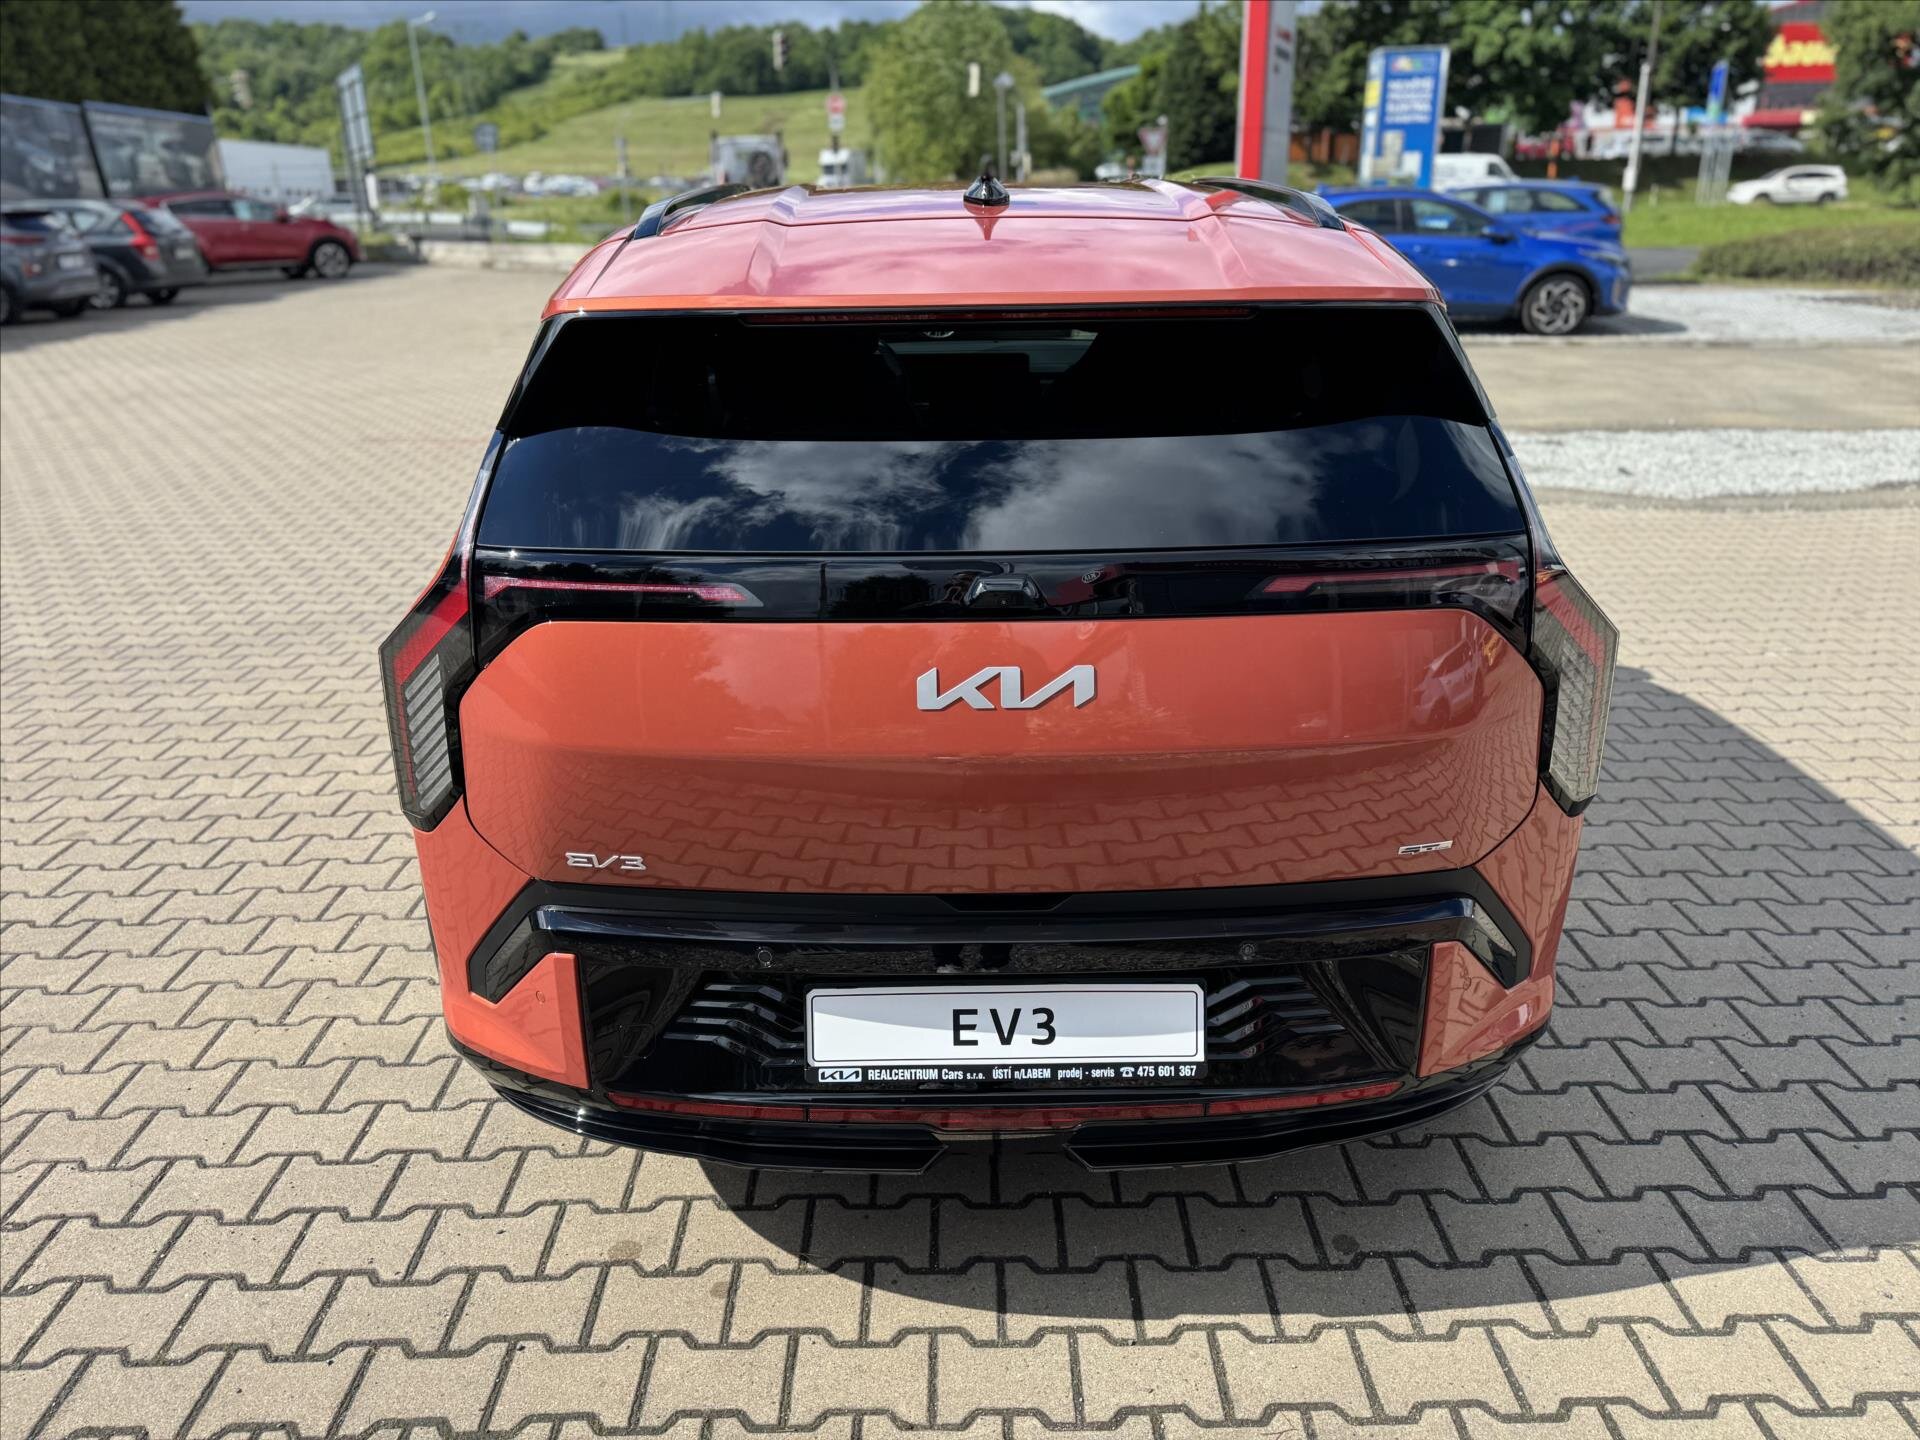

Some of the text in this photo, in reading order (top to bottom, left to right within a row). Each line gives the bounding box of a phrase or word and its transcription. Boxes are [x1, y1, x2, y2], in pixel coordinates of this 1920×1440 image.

[917, 665, 1095, 710] KIA
[565, 852, 647, 871] EV3
[821, 1069, 860, 1081] KIA
[868, 1068, 938, 1080] REALCENTRUM
[942, 1068, 964, 1080] Cars
[992, 1066, 1012, 1079] ÚSTÍ
[1014, 1067, 1051, 1080] n/LABEM
[1057, 1067, 1083, 1080] prodej
[1091, 1066, 1115, 1078] servis
[1137, 1066, 1155, 1077] 475
[1158, 1066, 1175, 1077] 601
[1179, 1065, 1197, 1077] 367
